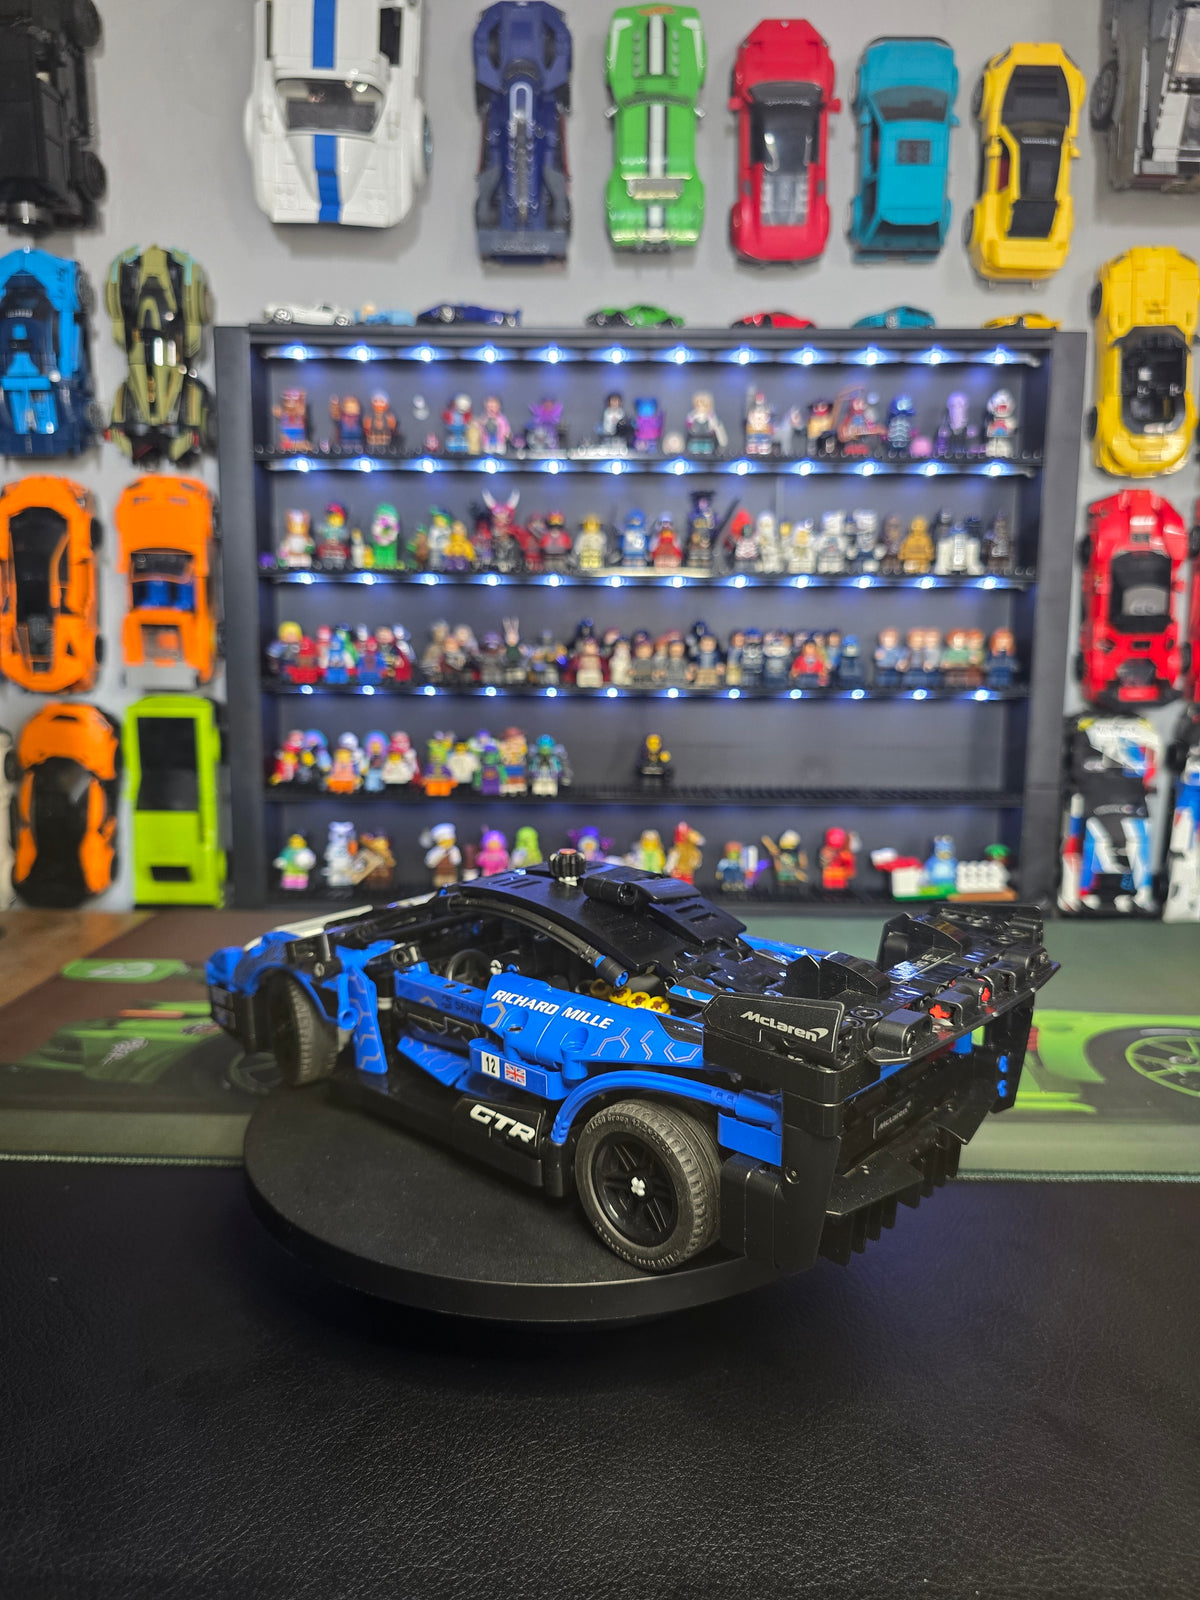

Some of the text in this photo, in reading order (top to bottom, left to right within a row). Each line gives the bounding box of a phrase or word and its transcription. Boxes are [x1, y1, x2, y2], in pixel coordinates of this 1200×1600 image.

[491, 989, 614, 1029] RICHARD MILLE
[740, 1011, 819, 1042] McLaren
[485, 1056, 496, 1074] 12
[469, 1103, 536, 1143] GTR
